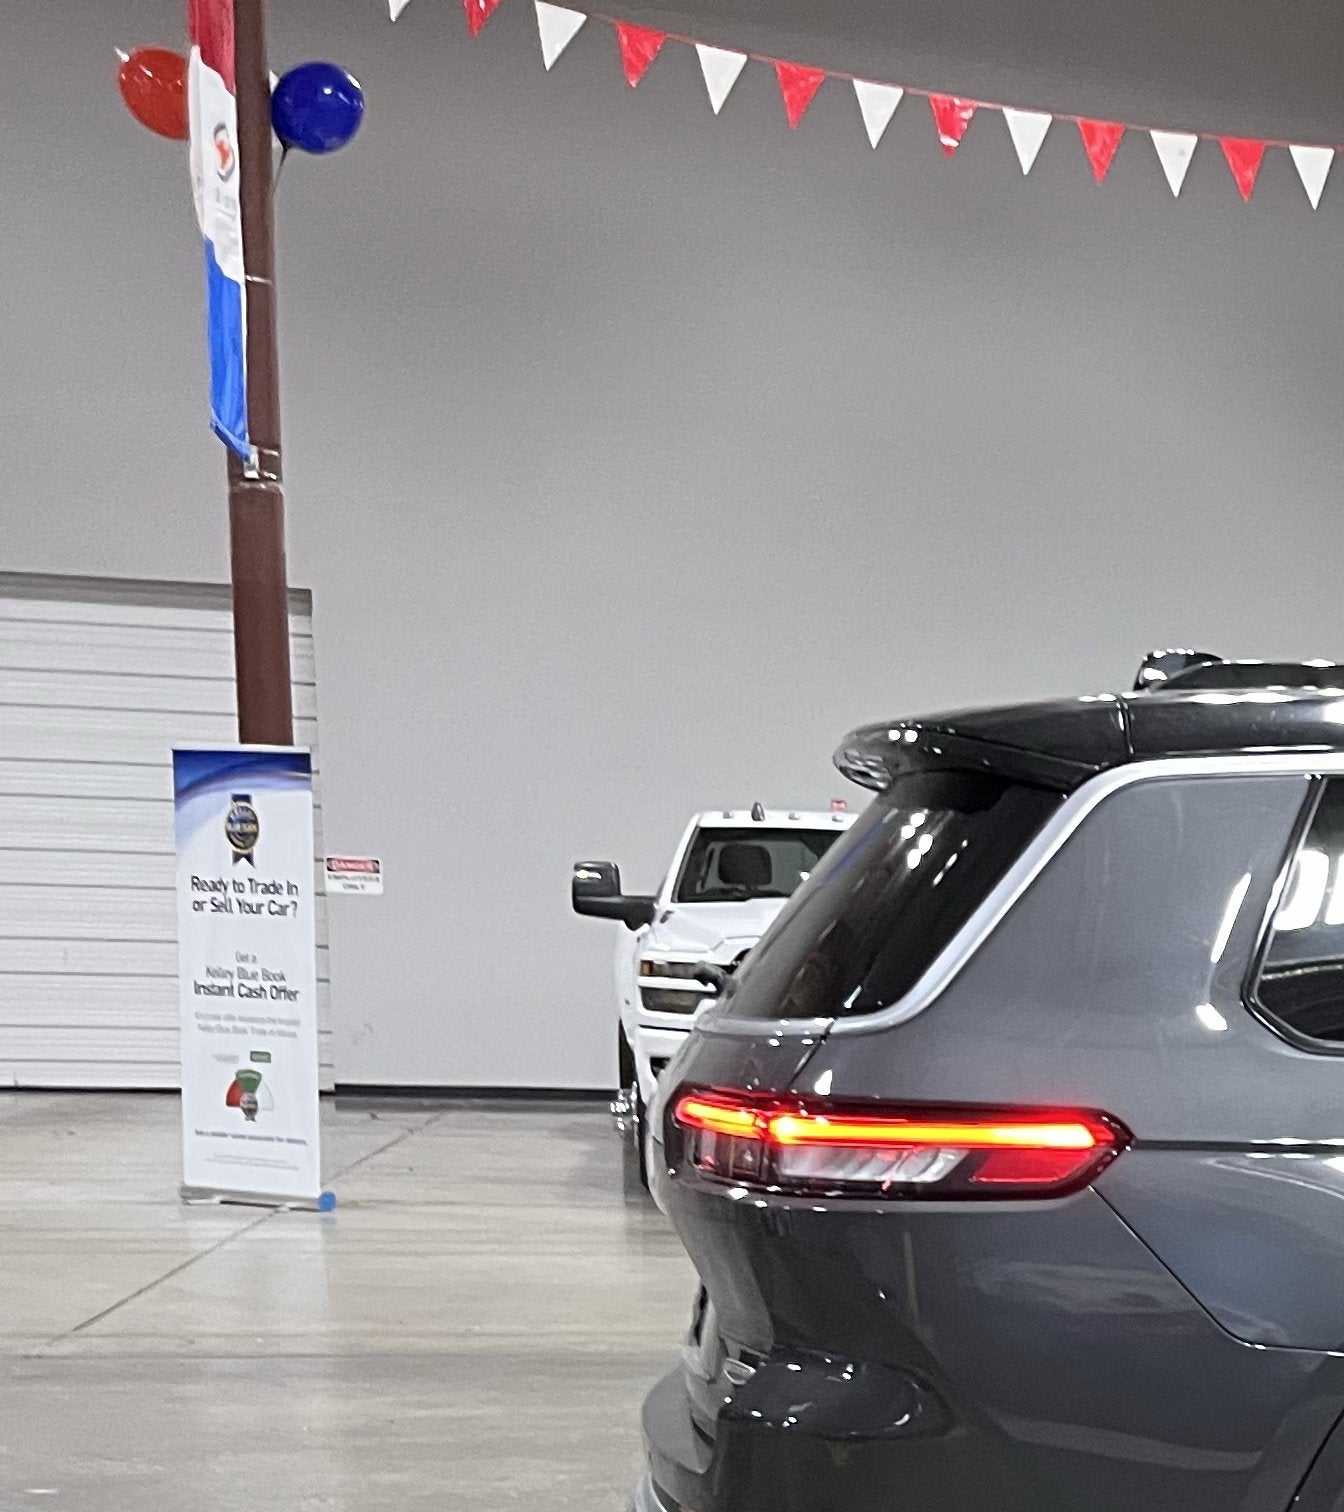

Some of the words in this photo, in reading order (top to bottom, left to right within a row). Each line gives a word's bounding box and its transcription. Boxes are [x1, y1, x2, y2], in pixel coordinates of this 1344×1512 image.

[191, 875, 228, 897] Ready
[232, 878, 245, 893] to
[248, 878, 283, 895] Trade
[286, 879, 299, 896] In
[192, 900, 207, 911] or
[210, 897, 233, 914] Sell
[236, 897, 264, 915] Your
[268, 900, 298, 918] Car?
[238, 983, 267, 999] Cash
